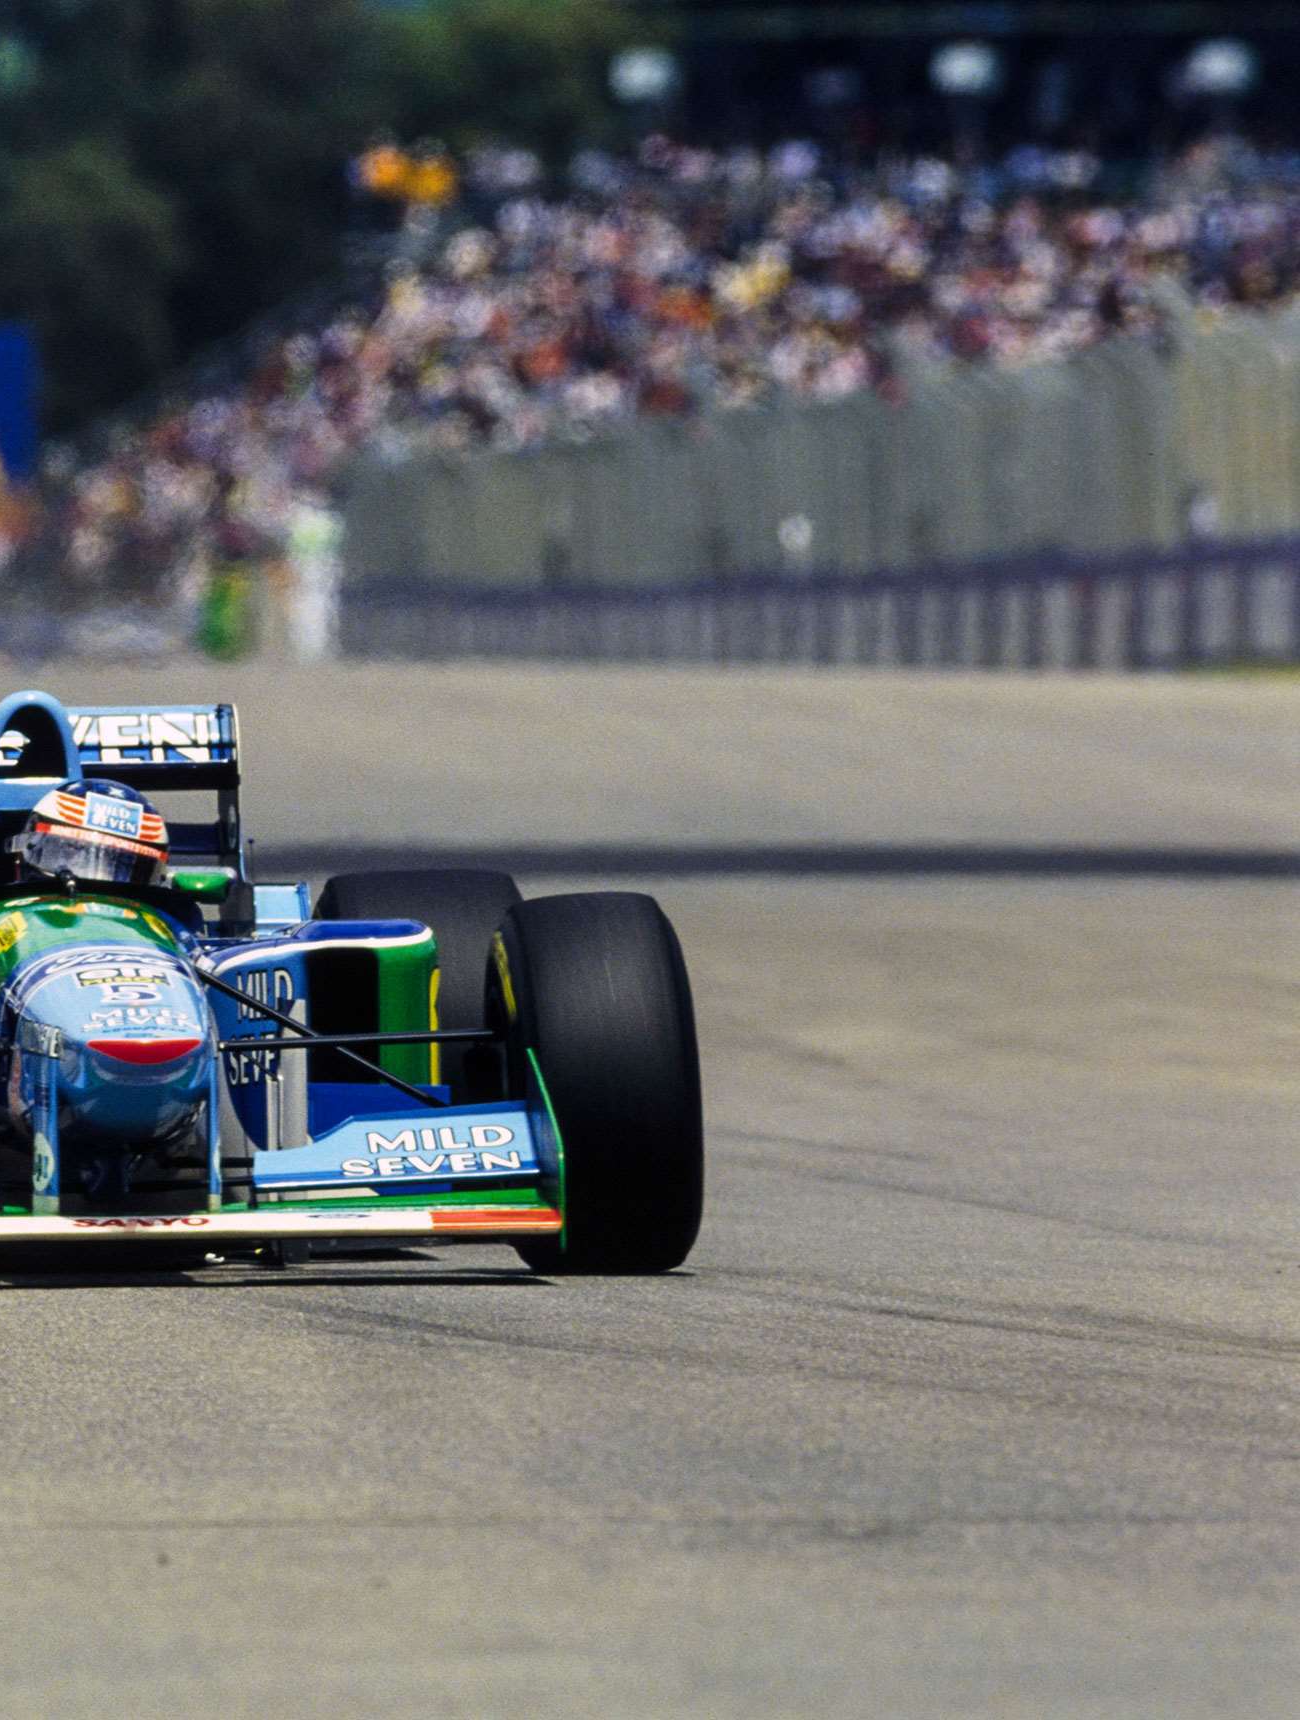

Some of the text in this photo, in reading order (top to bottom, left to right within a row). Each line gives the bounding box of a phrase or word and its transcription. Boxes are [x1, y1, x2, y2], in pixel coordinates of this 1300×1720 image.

[105, 982, 160, 1003] 5
[236, 969, 293, 1020] MILD
[365, 1124, 515, 1153] MILD
[340, 1151, 522, 1177] SEVEN
[73, 1217, 209, 1228] SANYO
